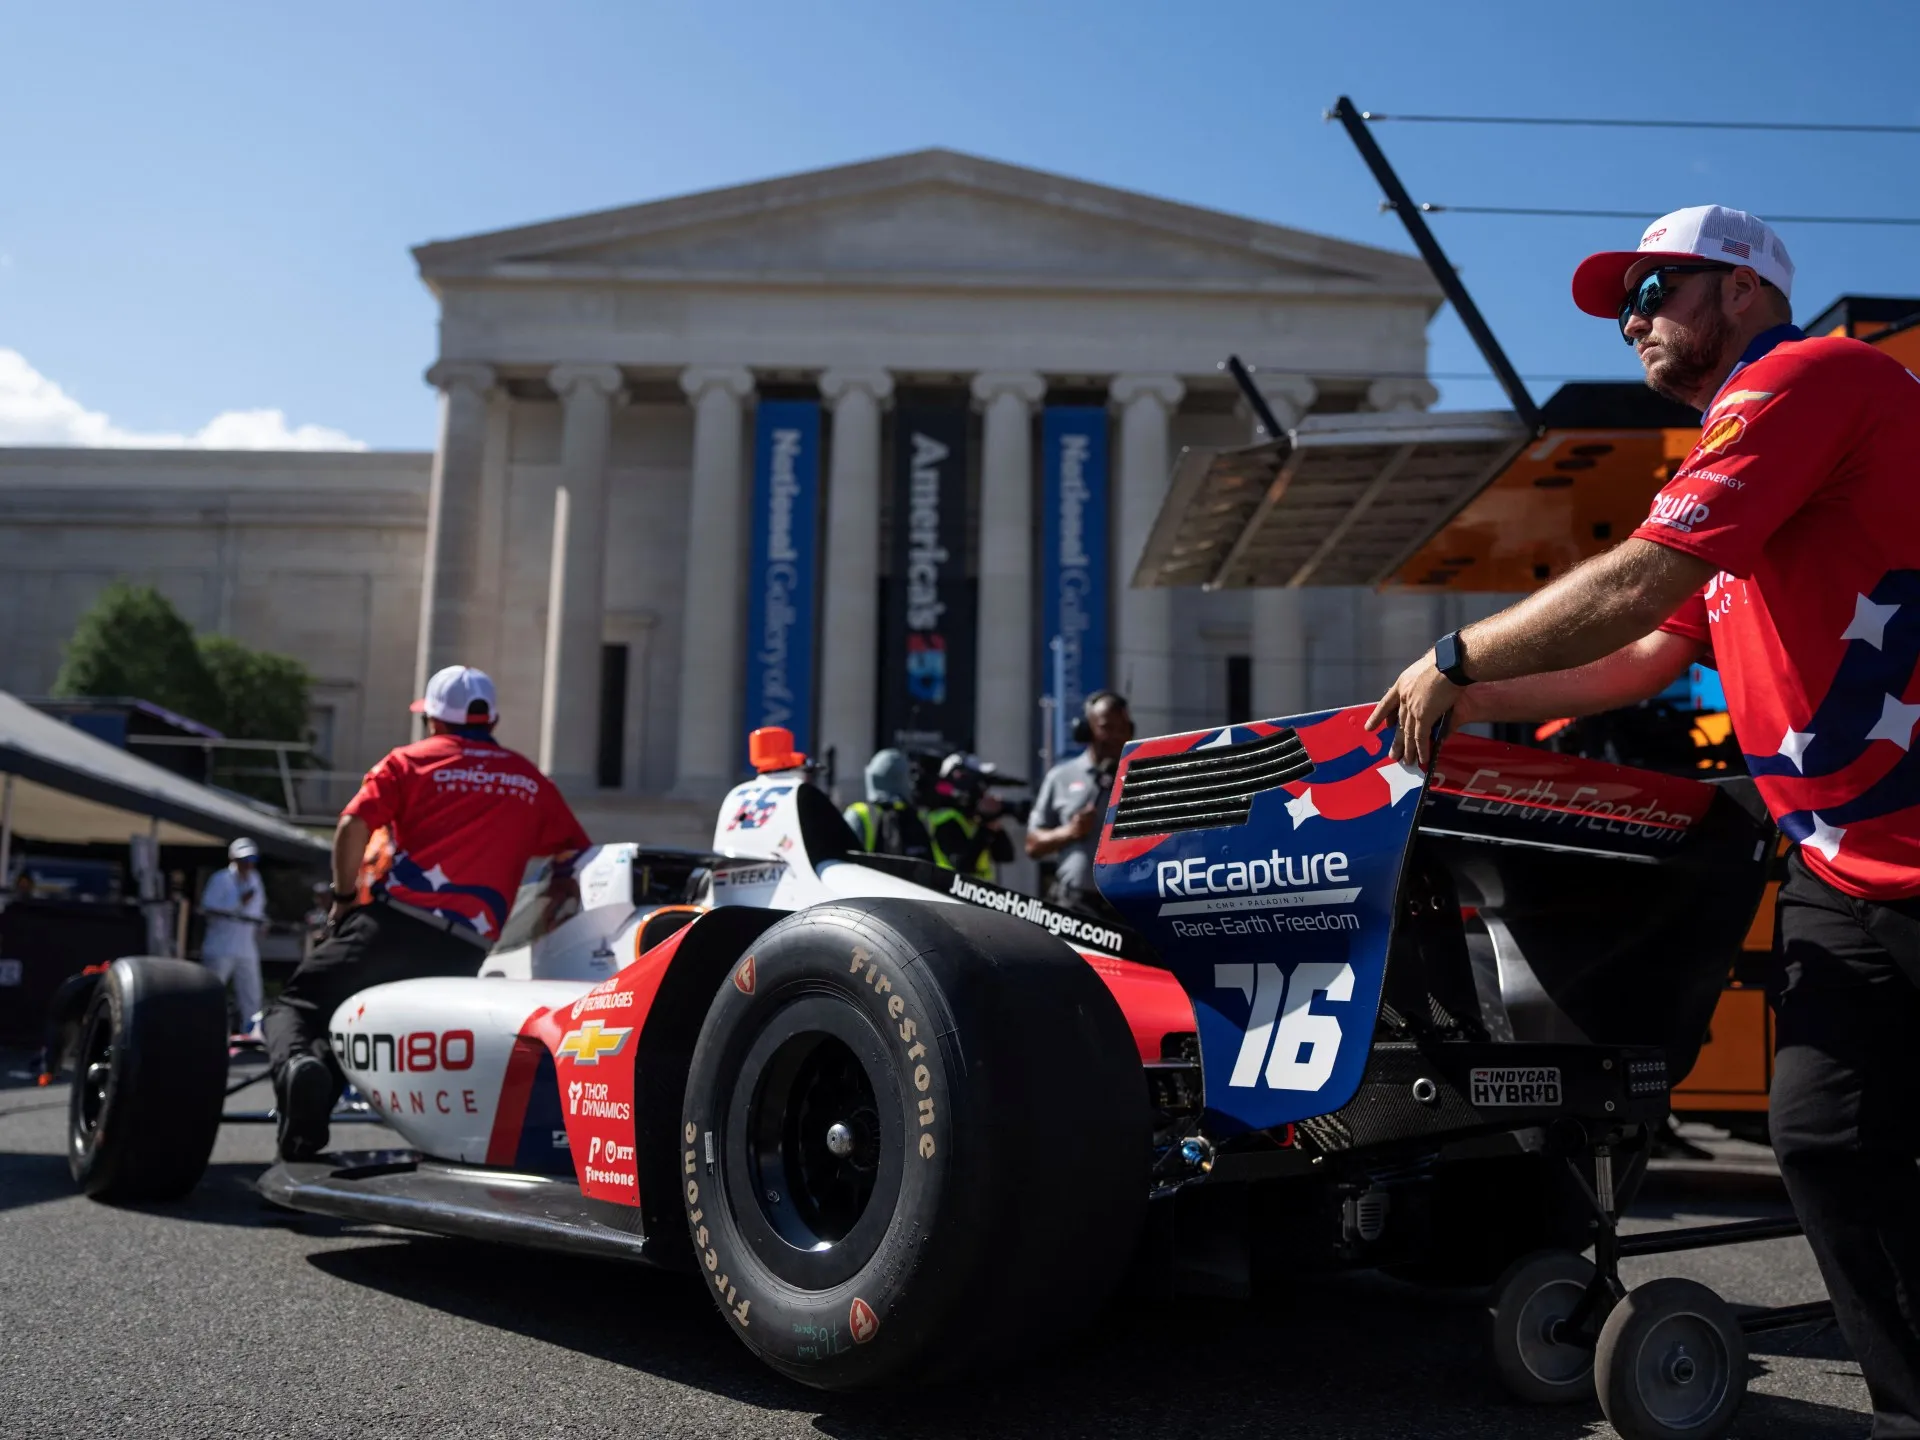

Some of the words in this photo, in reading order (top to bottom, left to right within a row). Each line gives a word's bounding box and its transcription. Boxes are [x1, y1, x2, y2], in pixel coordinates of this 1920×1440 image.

[769, 428, 800, 561] National
[909, 431, 949, 630] America's
[1060, 433, 1090, 566] National
[759, 562, 797, 665] Gallery
[1457, 769, 1557, 825] Earth
[1558, 786, 1692, 843] Freedom
[1157, 848, 1350, 898] REcapture
[1248, 897, 1289, 907] PALADIN
[949, 873, 1123, 952] JuncosHollinger.com
[1171, 914, 1272, 938] Rare-Earth
[1272, 911, 1361, 934] Freedom
[849, 945, 936, 1160] Firestone
[1214, 962, 1356, 1092] 76
[582, 1100, 630, 1120] DYNAMICS
[584, 1083, 608, 1101] THOR
[1490, 1070, 1556, 1083] INDYCAR
[585, 1166, 635, 1186] Firestone
[616, 1146, 634, 1160] NTT
[685, 1120, 751, 1327] Firestone
